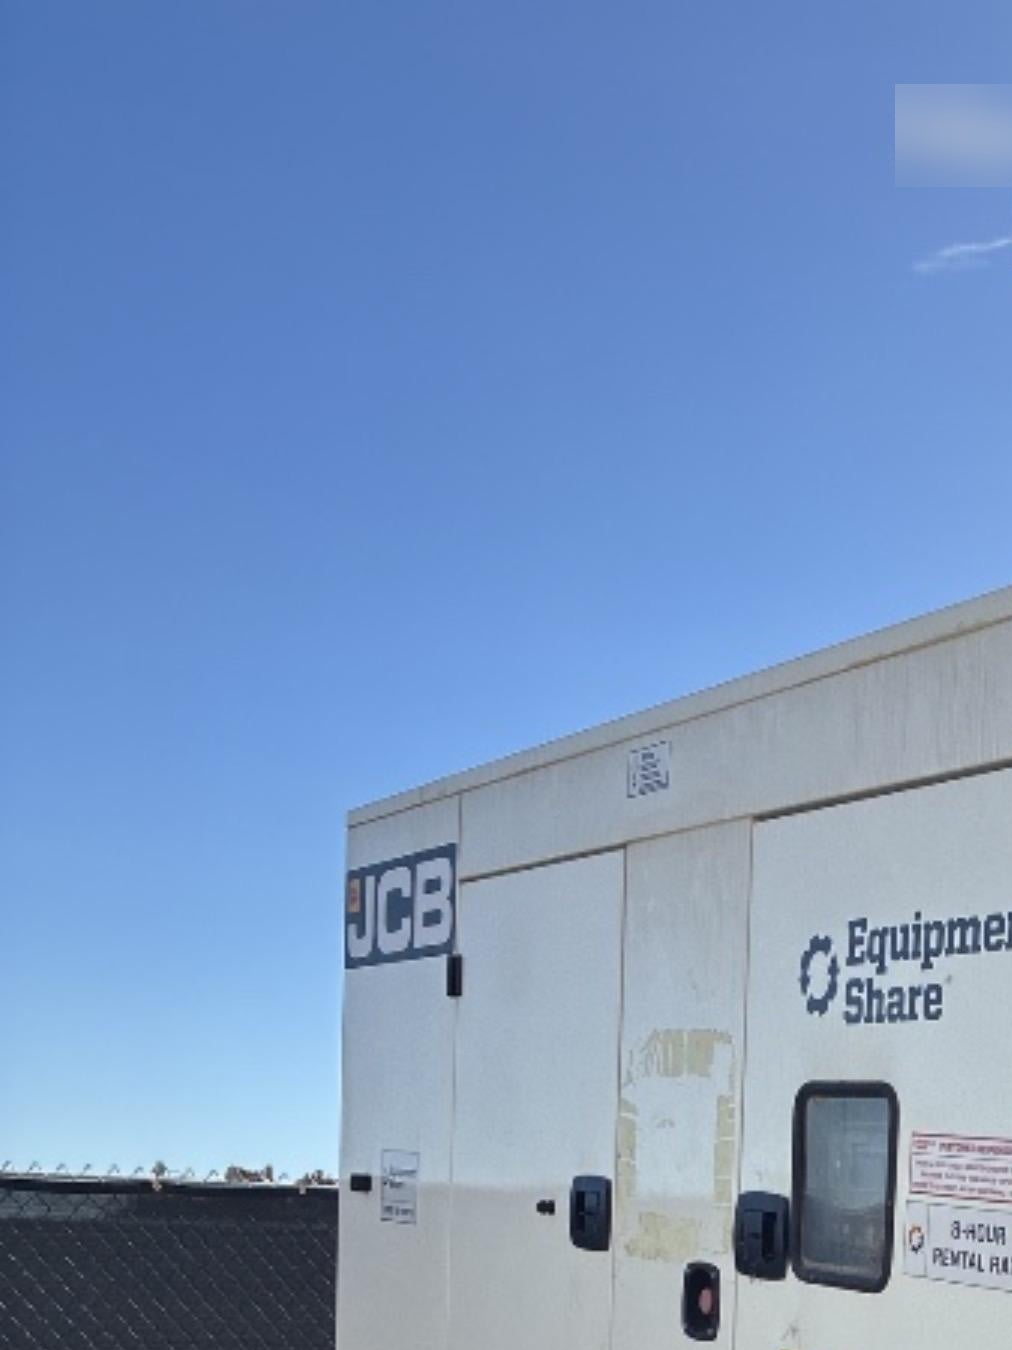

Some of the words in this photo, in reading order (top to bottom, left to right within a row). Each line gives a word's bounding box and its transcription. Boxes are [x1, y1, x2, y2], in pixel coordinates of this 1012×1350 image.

[347, 856, 452, 959] JCB
[843, 976, 944, 1024] Share
[951, 1220, 1007, 1246] 8-HOUR
[932, 1247, 985, 1273] RENTAL
